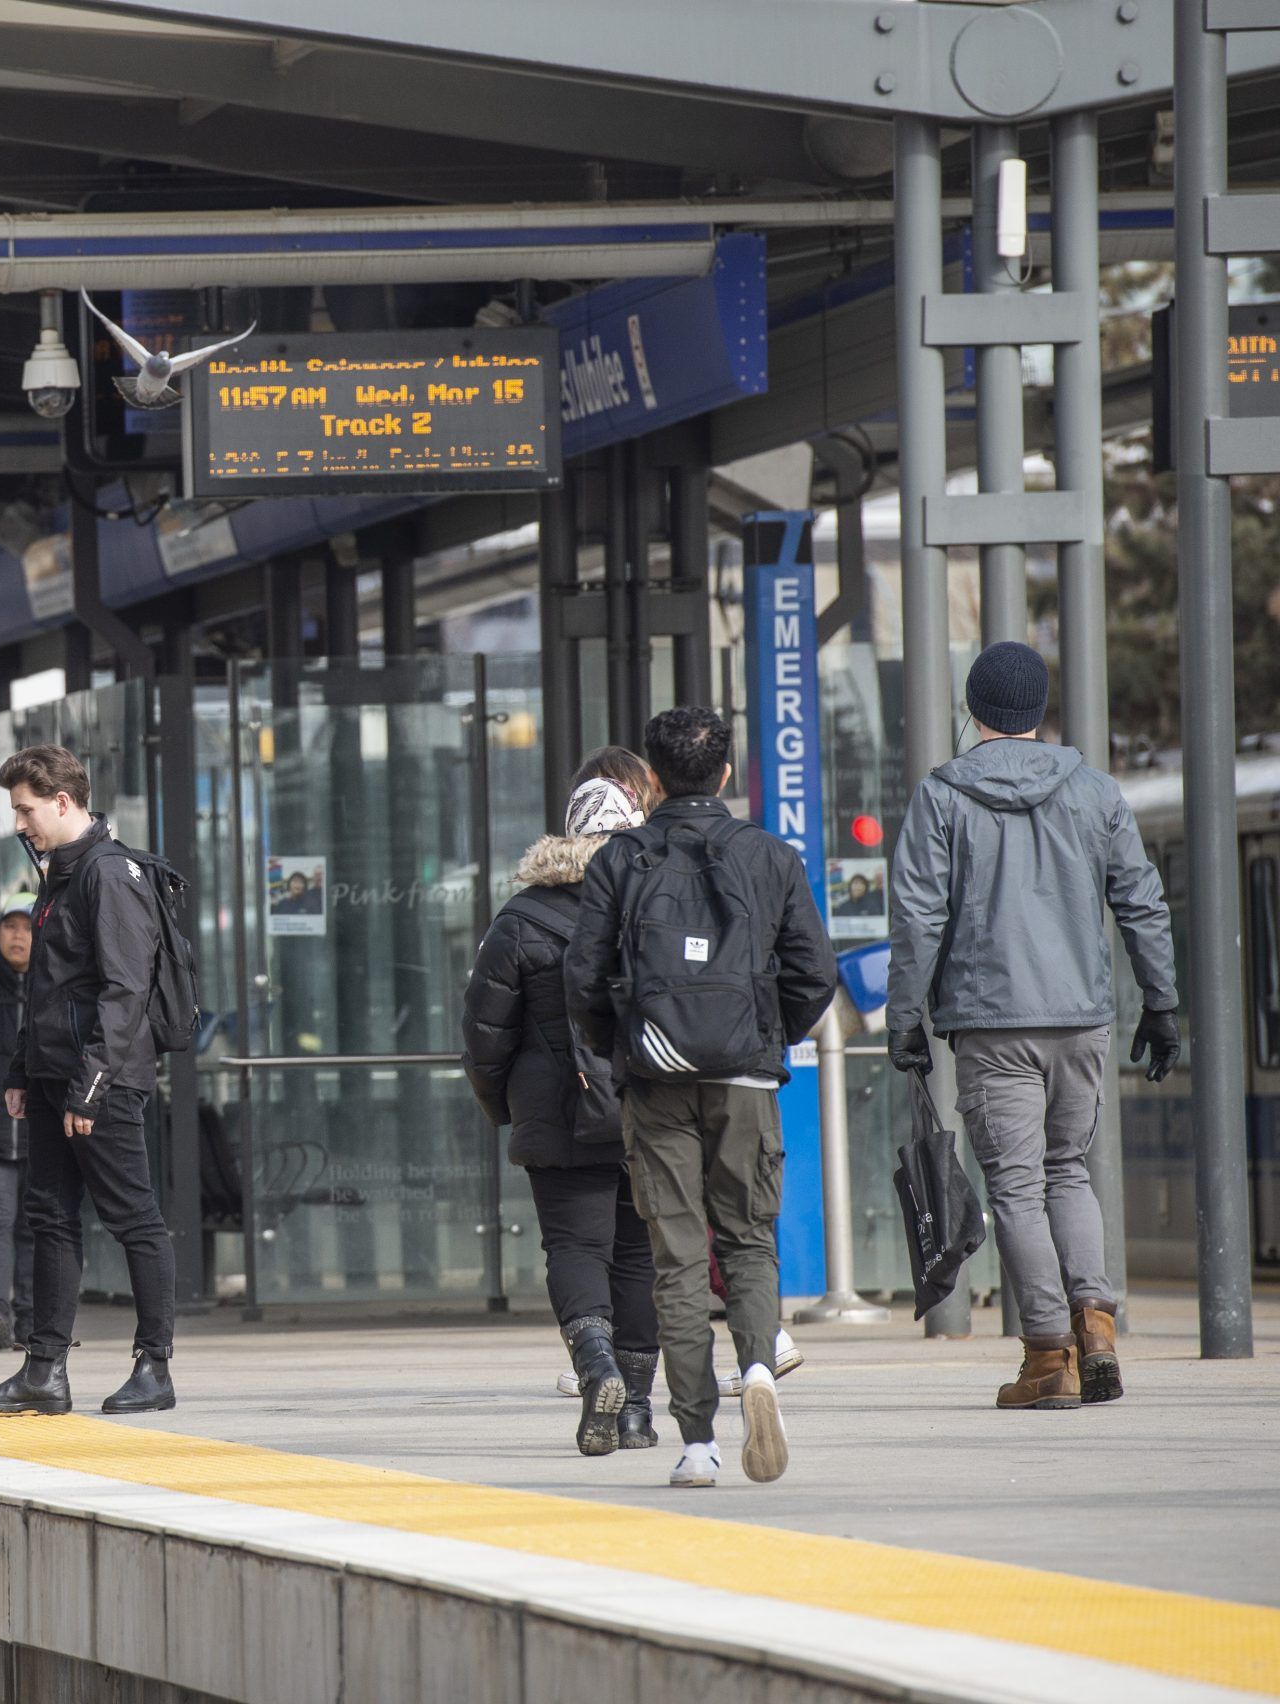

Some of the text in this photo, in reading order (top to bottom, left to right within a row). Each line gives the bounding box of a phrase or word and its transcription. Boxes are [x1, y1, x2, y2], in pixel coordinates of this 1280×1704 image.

[219, 386, 287, 406] 11:57
[291, 387, 326, 405] AM
[492, 378, 524, 400] 15
[320, 412, 432, 436] Track 2
[773, 577, 807, 867] EMERGEN
[331, 878, 404, 907] Pink
